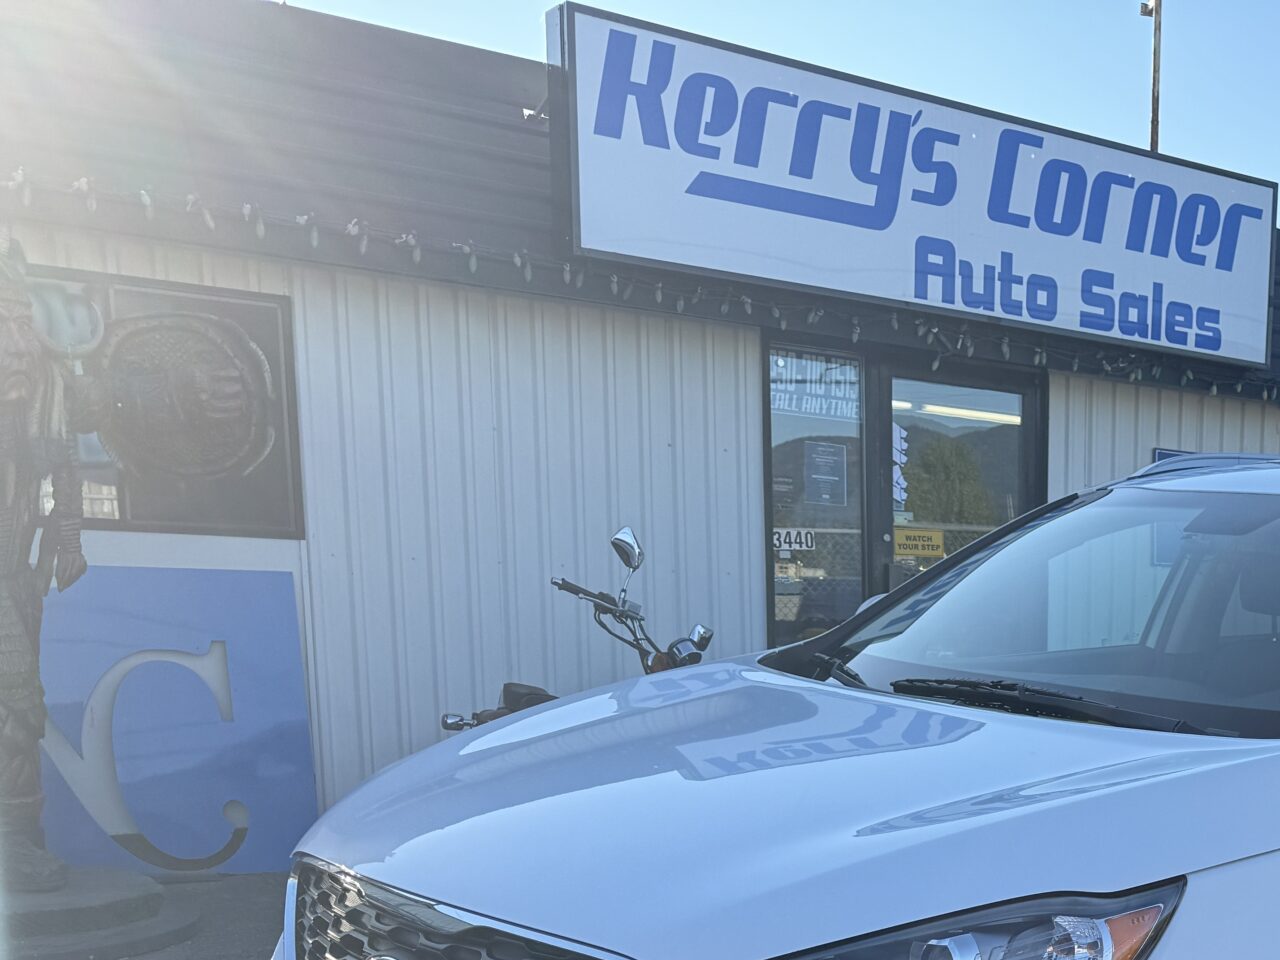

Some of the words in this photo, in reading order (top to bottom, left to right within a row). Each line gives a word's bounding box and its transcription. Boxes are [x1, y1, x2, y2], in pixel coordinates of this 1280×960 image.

[593, 28, 960, 231] Kerry's
[986, 128, 1263, 272] Corner
[914, 236, 1058, 322] Auto
[1079, 268, 1222, 352] Sales
[770, 391, 799, 411] CALL
[802, 396, 860, 418] ANYTIME
[773, 531, 814, 549] 3440
[897, 543, 919, 551] YOUR
[921, 543, 941, 551] STEP
